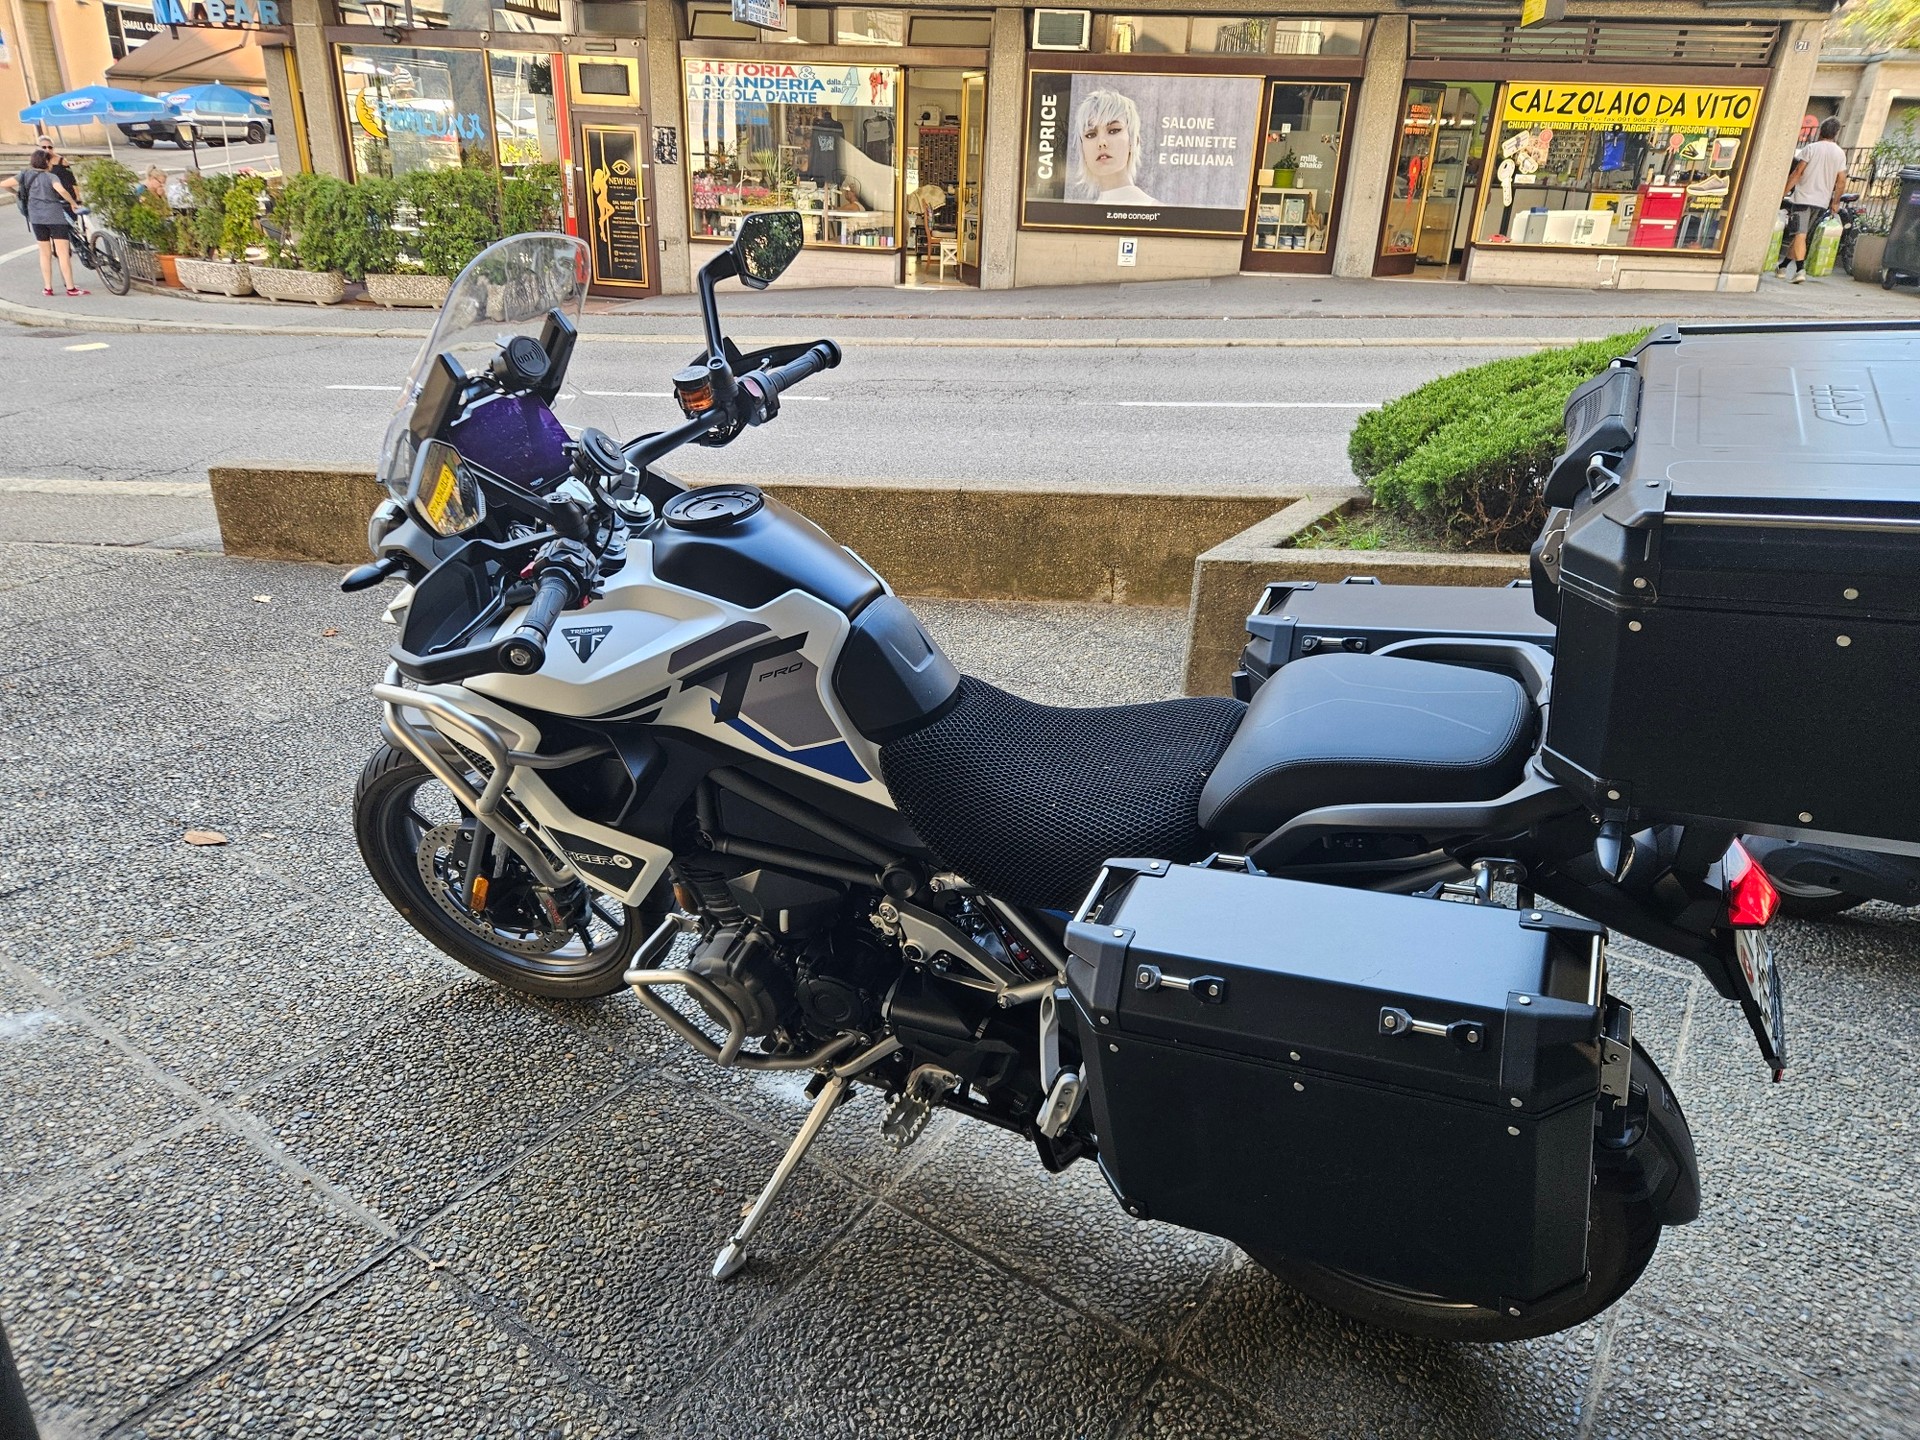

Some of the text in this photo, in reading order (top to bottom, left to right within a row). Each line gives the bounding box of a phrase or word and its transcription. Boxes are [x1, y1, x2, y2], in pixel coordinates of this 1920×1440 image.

[206, 0, 281, 25] BAR
[122, 20, 146, 31] SMALL
[687, 62, 816, 80] SARTORIA &
[826, 66, 861, 86] dalla A
[688, 75, 826, 91] LAVANDERIA
[703, 88, 763, 102] REGOLA
[766, 91, 817, 104] D'ARTE
[840, 84, 858, 106] Z
[1510, 88, 1752, 120] CALZOLAIO DA VITO
[1161, 116, 1215, 130] SALONE
[1507, 121, 1533, 129] CHIAVI
[1540, 121, 1572, 130] CILINDRI
[1573, 122, 1587, 130] PER
[1589, 123, 1614, 132] PORTE
[1671, 125, 1707, 135] INCISIONI
[1715, 126, 1743, 136] TIMBRI
[1037, 94, 1057, 180] CAPRICE
[1159, 135, 1237, 149] JEANNETTE
[1159, 153, 1234, 167] E GIULIANA
[1300, 154, 1319, 162] milk
[608, 177, 637, 187] NEW IRIS
[1106, 212, 1127, 220] z.one
[1123, 242, 1133, 253] P
[759, 662, 803, 682] PRO
